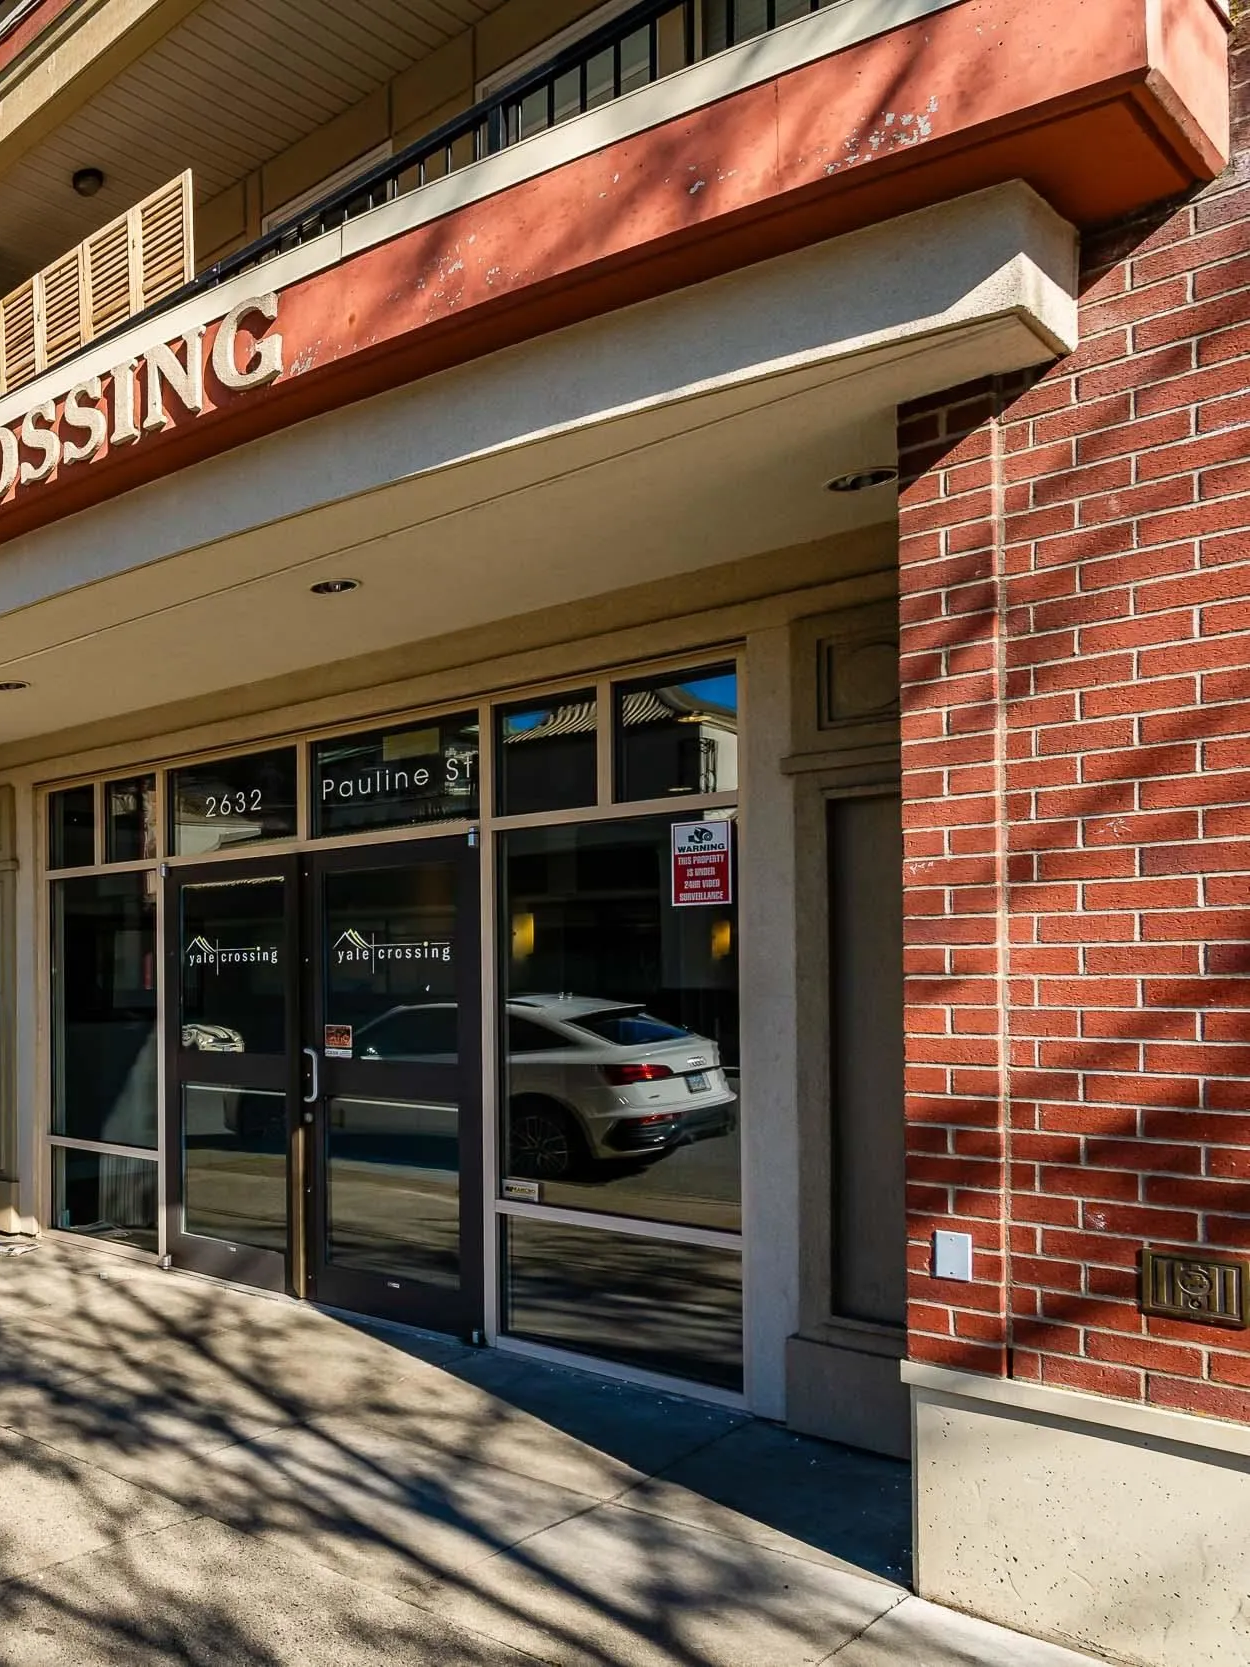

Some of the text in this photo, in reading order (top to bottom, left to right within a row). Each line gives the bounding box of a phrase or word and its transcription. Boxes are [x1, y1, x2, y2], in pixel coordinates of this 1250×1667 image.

[204, 756, 474, 819] 2632 Pauline St
[677, 843, 725, 853] WARNING
[678, 854, 725, 865] THIS PROPERTY
[686, 867, 715, 877] IS UNDER
[684, 879, 720, 889] 24HR VIDEO
[679, 891, 724, 902] SURVEILLANCE
[189, 946, 278, 967] yale crossing
[337, 941, 451, 964] yale crossing
